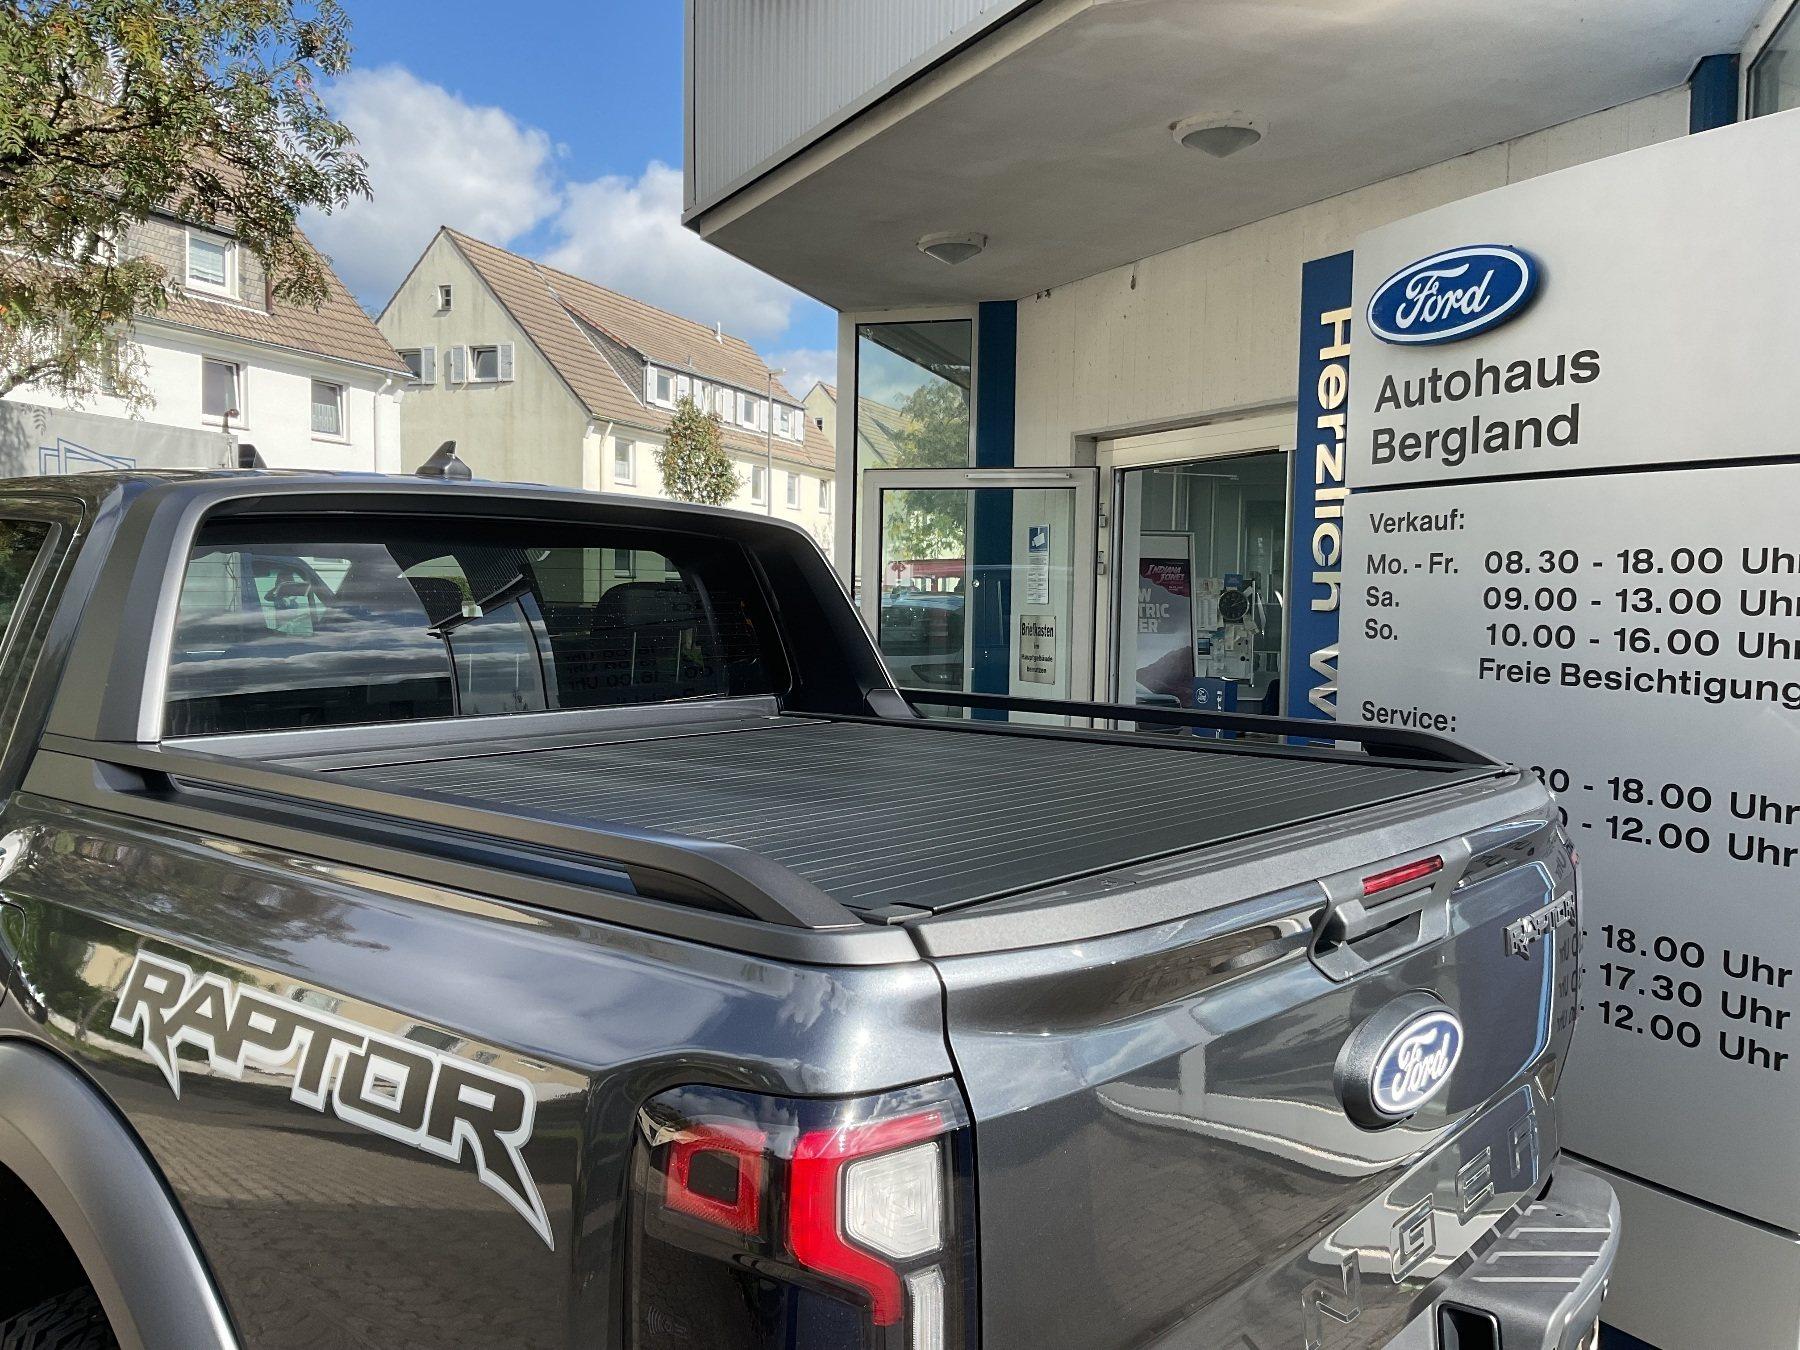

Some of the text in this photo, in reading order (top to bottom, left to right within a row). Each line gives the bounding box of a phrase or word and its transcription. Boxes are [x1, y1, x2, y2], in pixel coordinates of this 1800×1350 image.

[1395, 263, 1495, 329] Ford
[1374, 348, 1601, 414] Autohaus
[1311, 307, 1352, 612] Herzlich
[1371, 403, 1580, 468] Bergland
[1369, 508, 1465, 534] Verkauf:
[1366, 553, 1408, 575] Mo.
[1429, 552, 1459, 574] Fr.
[1484, 549, 1580, 575] 08.30
[1616, 547, 1723, 574] 18.00
[1742, 547, 1800, 575] Uh
[1366, 585, 1400, 608] Sa.
[1483, 586, 1578, 612] 09.00
[1615, 588, 1722, 615] 13.00
[1021, 622, 1054, 638] Briefkasten
[1364, 617, 1399, 641] So.
[1486, 623, 1577, 650] 10.00
[1613, 627, 1720, 656] 16.00
[1478, 657, 1800, 710] Freie Besichtigung
[1361, 700, 1457, 733] Service:
[1607, 776, 1712, 813] 18.00
[1730, 791, 1800, 825] Uhr
[1605, 815, 1710, 853] 12.00
[1728, 832, 1799, 867] Uhr
[1601, 924, 1705, 968] 18.00
[1723, 949, 1793, 988] Uhr
[1600, 962, 1791, 1029] 17.30 Uhr
[1391, 1027, 1449, 1101] Ford
[1598, 1000, 1789, 1072] 12.00 Uhr
[110, 949, 555, 1252] RAPTOR
